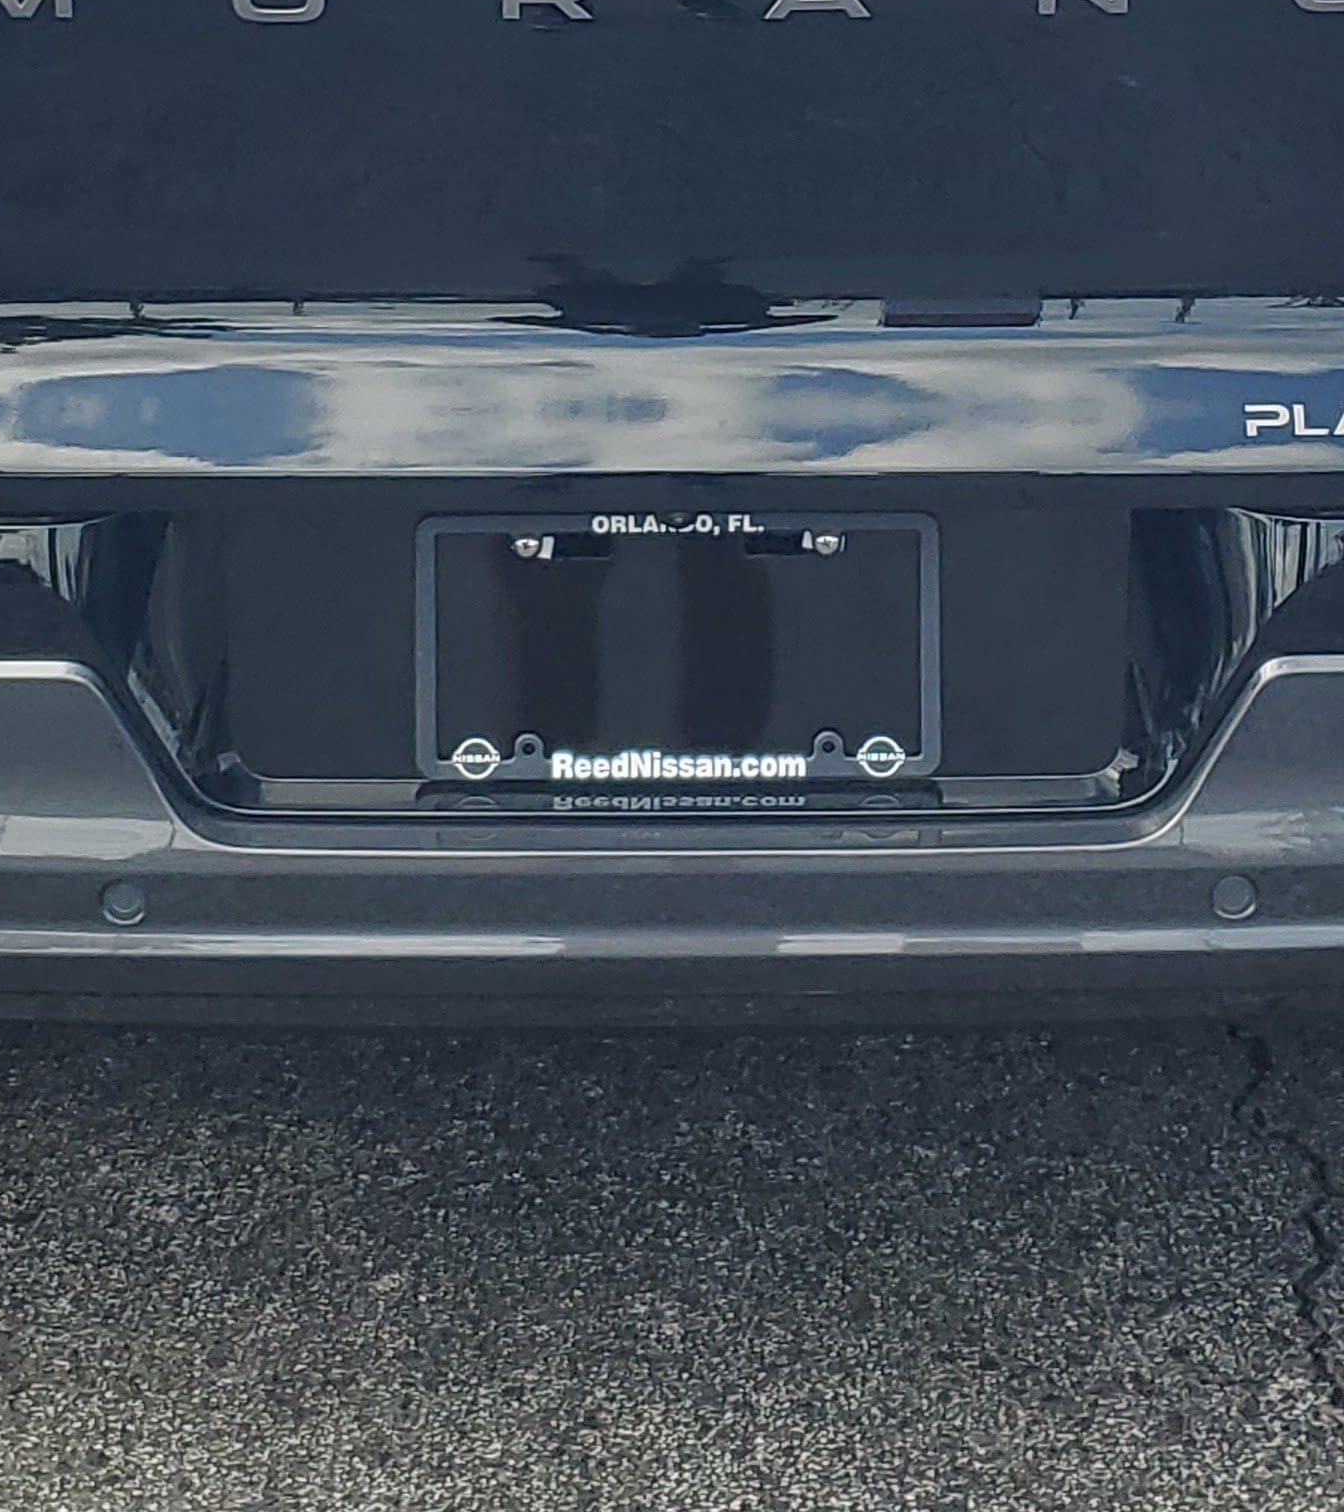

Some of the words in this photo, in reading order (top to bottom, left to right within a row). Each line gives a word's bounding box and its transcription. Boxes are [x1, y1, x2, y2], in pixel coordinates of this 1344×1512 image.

[591, 513, 721, 536] ORLAO,
[727, 514, 765, 533] FL.
[452, 754, 500, 764] NISSAN
[552, 751, 806, 779] ReedNissan.com
[856, 752, 905, 762] NISSAN
